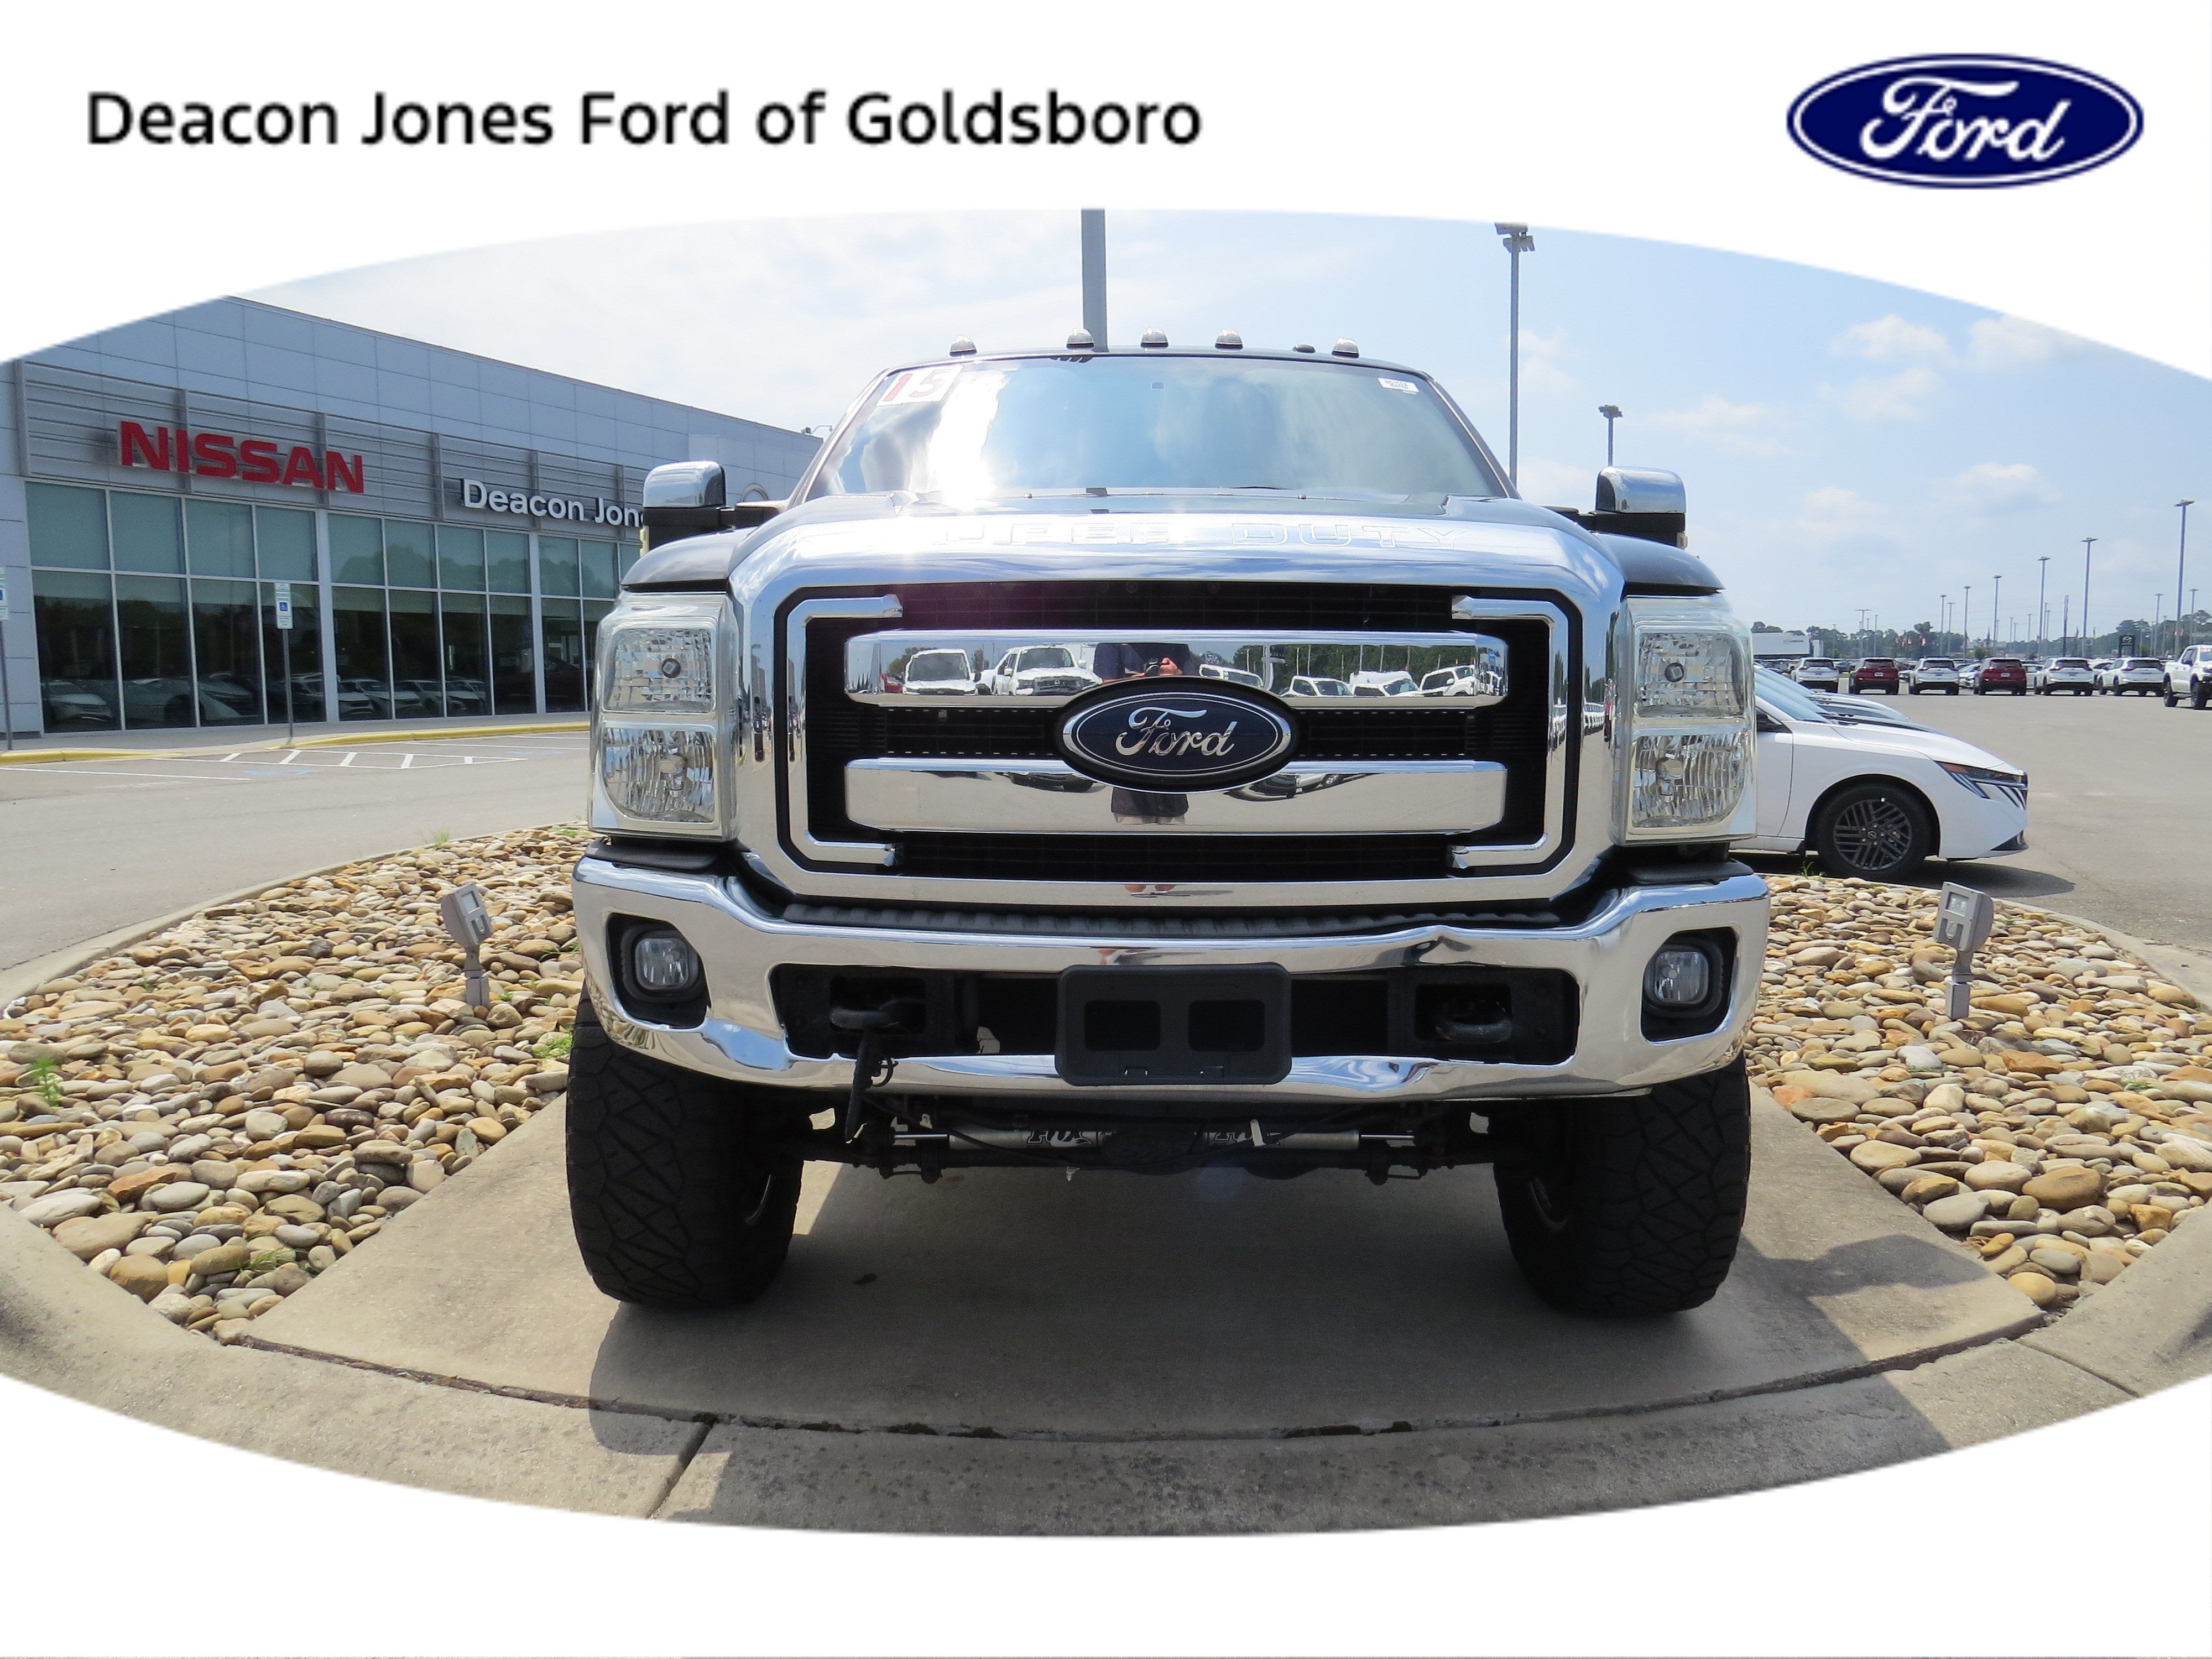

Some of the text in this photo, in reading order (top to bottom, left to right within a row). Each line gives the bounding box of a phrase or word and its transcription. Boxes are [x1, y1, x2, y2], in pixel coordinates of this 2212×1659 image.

[120, 420, 364, 494] NISSAN
[463, 478, 644, 528] Deacon Jon
[1232, 523, 1469, 549] DUTY
[1115, 706, 1238, 757] Ford
